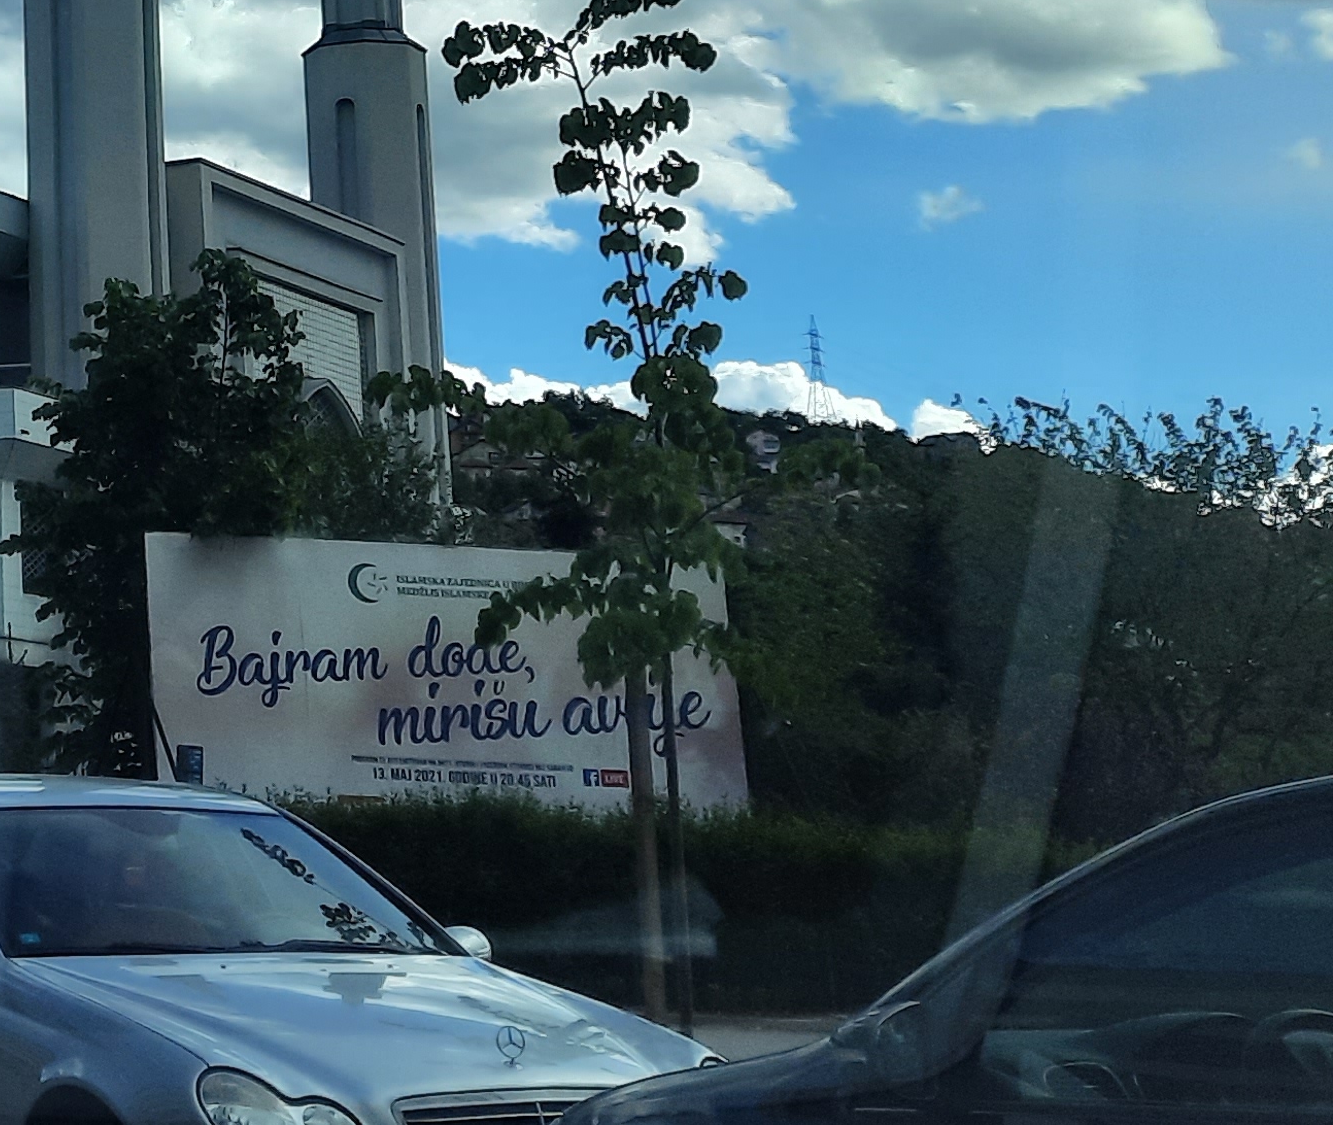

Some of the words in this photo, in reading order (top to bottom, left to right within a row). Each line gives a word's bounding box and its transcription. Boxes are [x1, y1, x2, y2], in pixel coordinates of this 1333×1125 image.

[196, 624, 388, 708] Bajram
[376, 679, 553, 746] mirišu
[391, 768, 412, 781] MAJ
[533, 774, 557, 788] SATI
